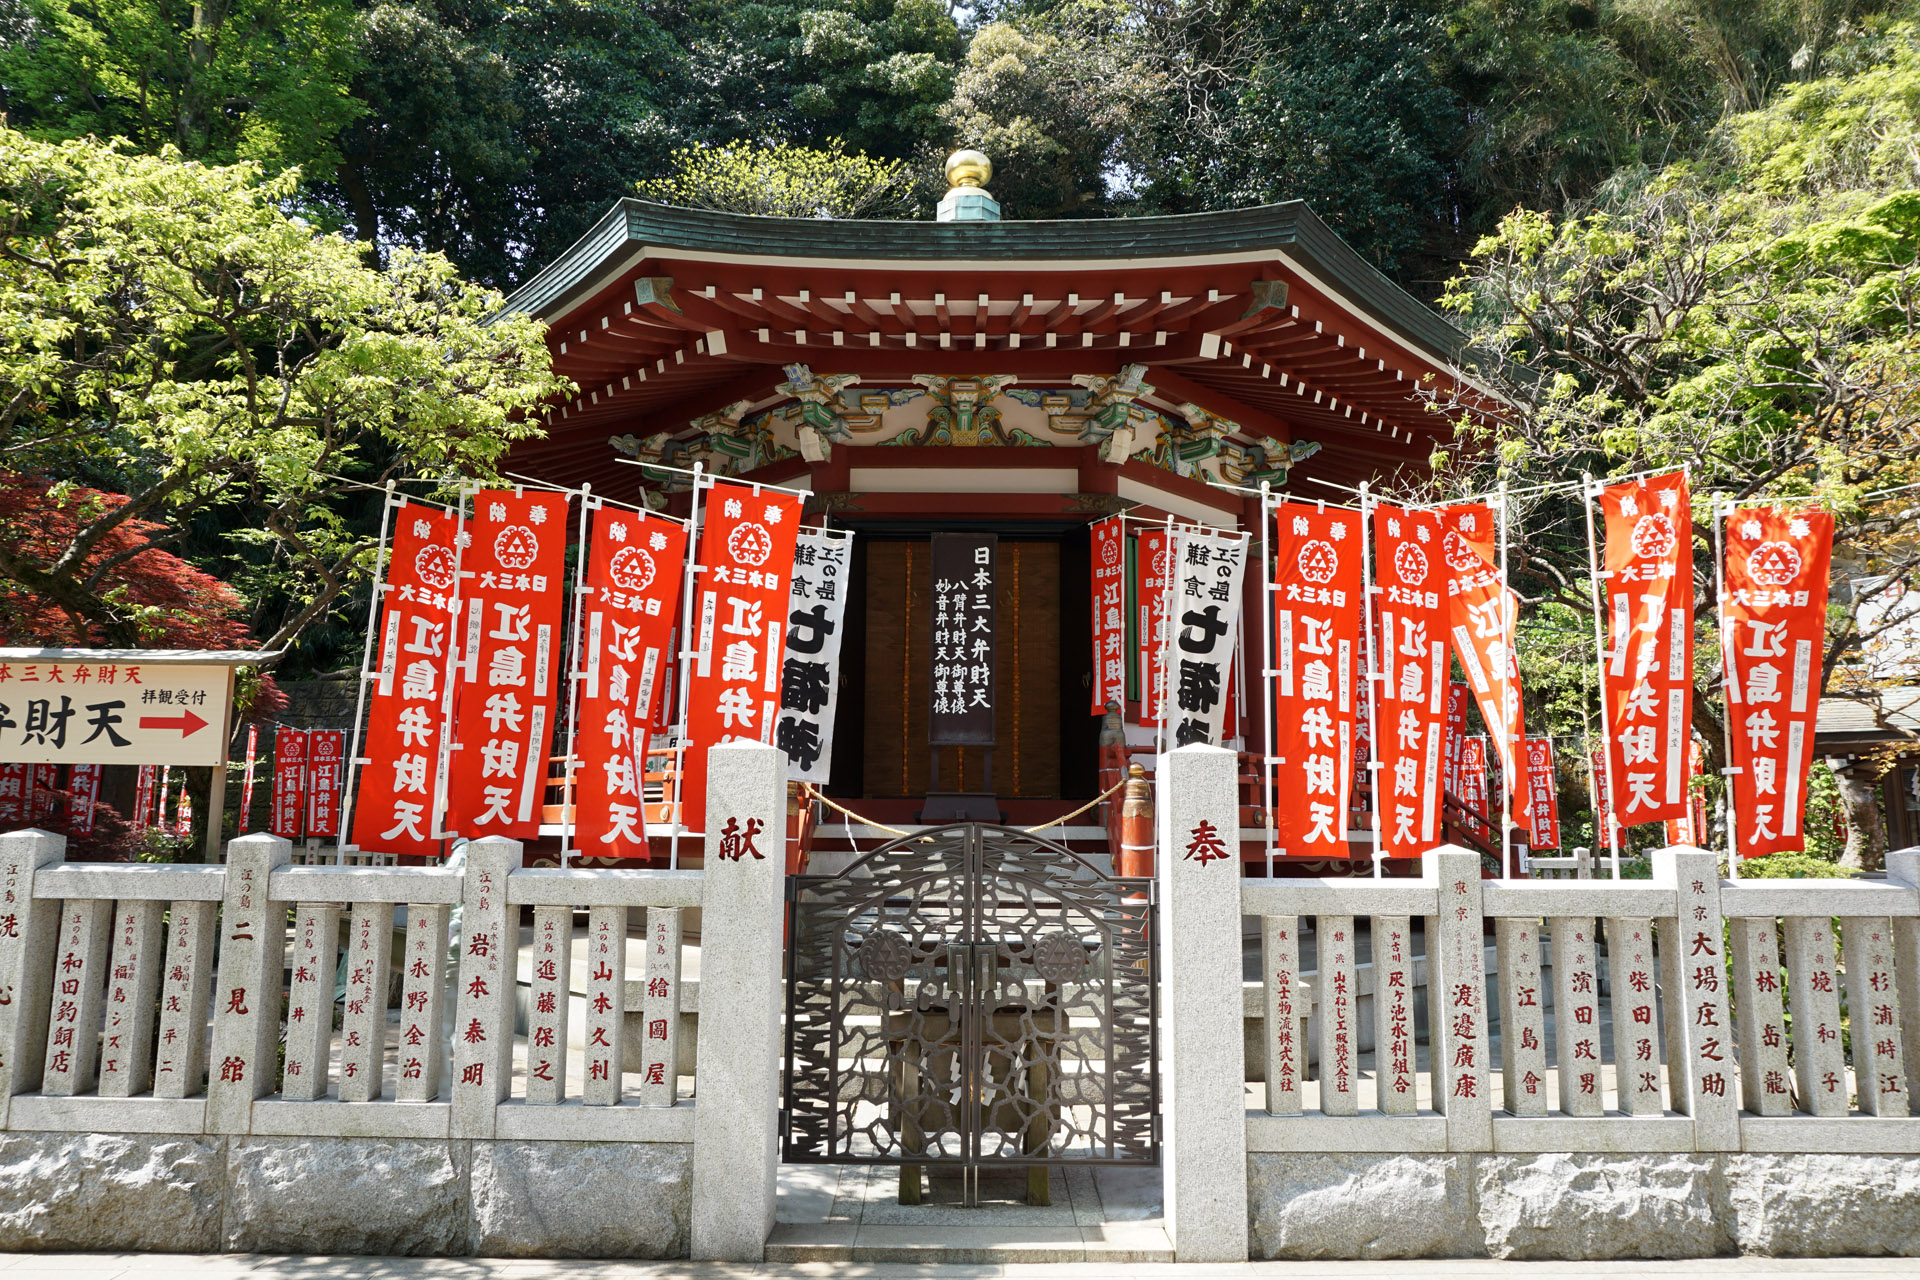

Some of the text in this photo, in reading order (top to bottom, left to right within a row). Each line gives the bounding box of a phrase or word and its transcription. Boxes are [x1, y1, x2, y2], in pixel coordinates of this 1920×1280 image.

[933, 578, 952, 714] 妙音弁財天御尊像
[950, 579, 970, 714] 八臂弁財天御尊像
[969, 546, 993, 708] 日本三大弁財天
[141, 689, 207, 706] 拝観受付
[283, 766, 298, 833] 江島弁財天
[315, 764, 332, 833] 江島弁財天
[718, 817, 765, 863] 献
[1183, 819, 1231, 868] 奉
[1532, 775, 1554, 847] 江島弁財天
[5, 864, 18, 904] 江の島
[125, 915, 135, 946] 江の島
[304, 918, 316, 949] 江の島
[656, 923, 667, 956] 江の島
[1334, 931, 1345, 964] 横浜
[1390, 931, 1401, 963] 加古川
[1454, 880, 1469, 922] 東京
[1519, 932, 1529, 964] 東京
[50, 915, 83, 1073] 江の島 和田釣餌店
[160, 916, 189, 1072] 江の島 湯浅平二
[219, 868, 254, 1083] 江の島 二見館
[345, 918, 371, 1078] 江の島 長塚長子
[403, 918, 430, 1080] 東京 永野金治
[461, 870, 491, 1087] 江の島 岩本泰明
[533, 921, 557, 1082] 江の島 進藤保之
[589, 921, 614, 1081] 江の島 山本久利
[1277, 930, 1295, 1092] 東京 富士物流株式会社
[1572, 932, 1597, 1094] 東京 濱田政男
[1629, 932, 1659, 1093] 東京 柴田勇次
[1690, 880, 1726, 1097] 東京 大場庄之助
[1811, 970, 1840, 1093] 境和子
[1869, 932, 1902, 1094] 東京 杉浦時江
[1517, 986, 1541, 1095] 江島會
